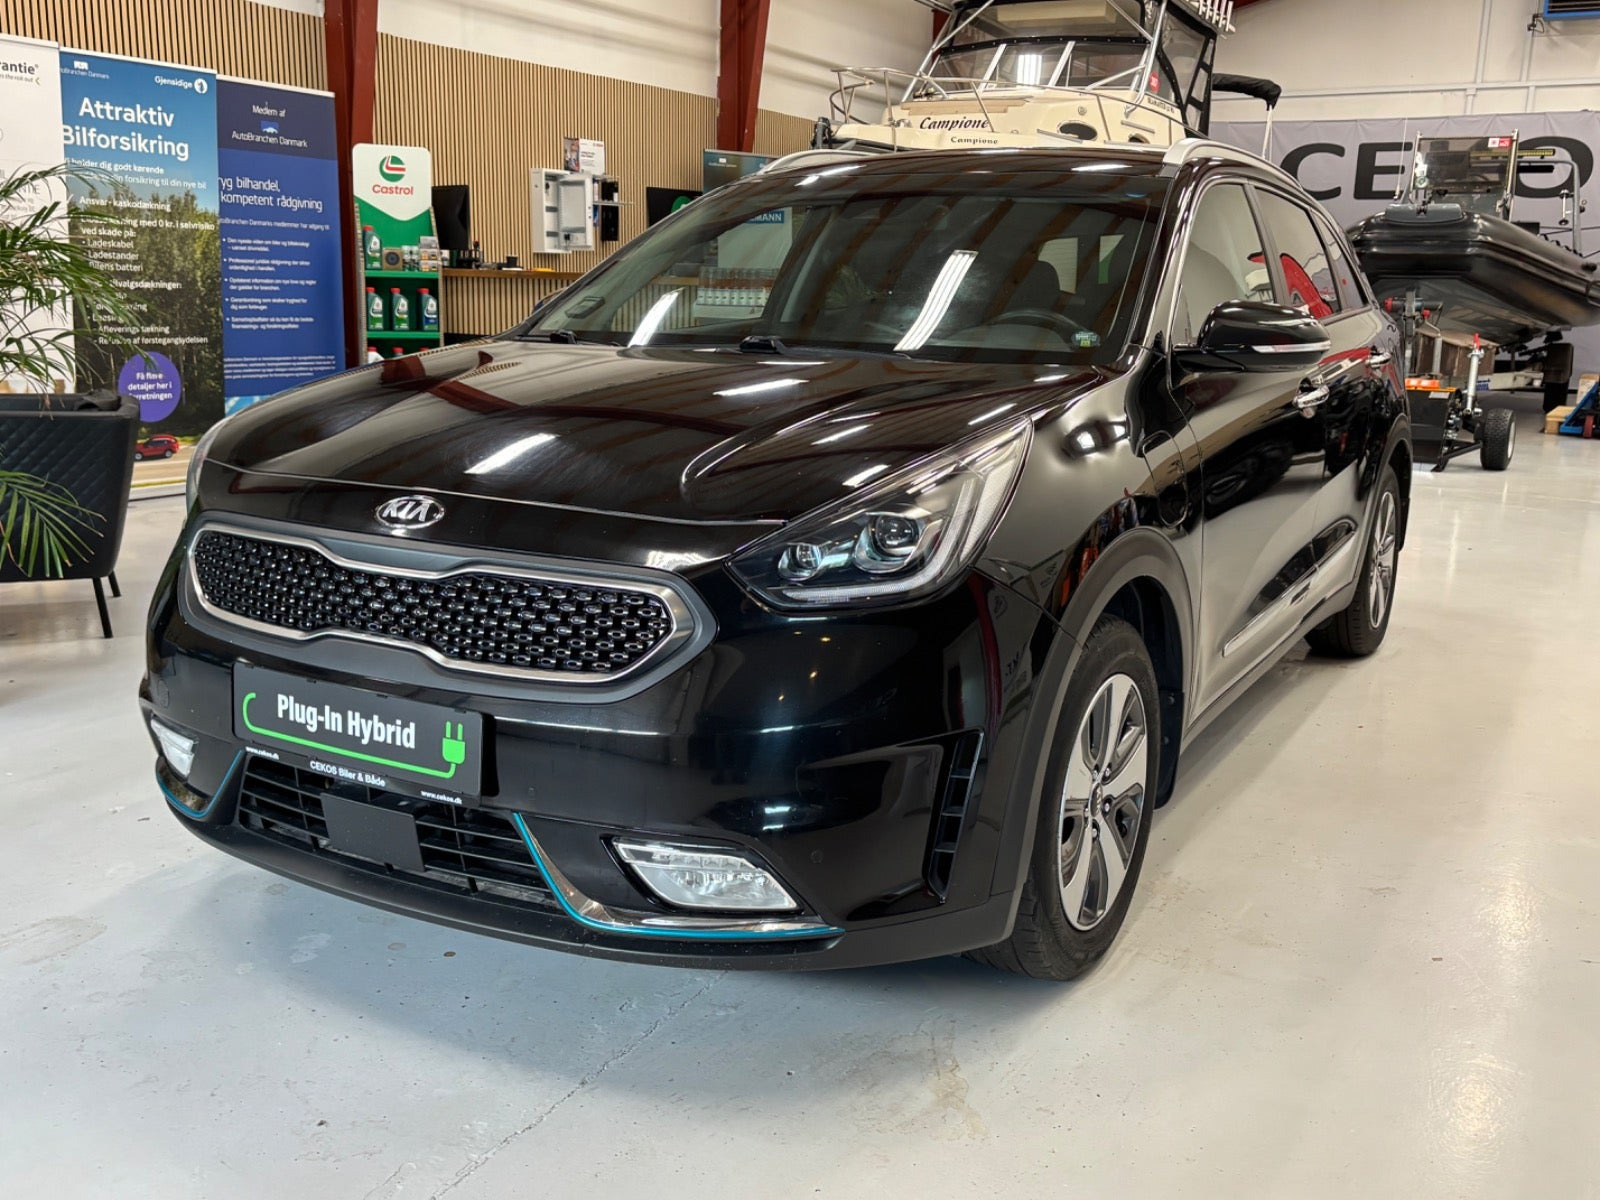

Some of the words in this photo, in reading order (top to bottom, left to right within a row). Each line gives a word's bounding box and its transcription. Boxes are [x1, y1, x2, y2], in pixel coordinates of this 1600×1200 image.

[155, 75, 192, 89] Gjensidige
[79, 97, 174, 127] Attraktiv
[279, 109, 286, 118] af
[920, 116, 989, 131] Campione
[62, 124, 189, 162] Bilforsikring
[232, 130, 278, 144] AutoBranchen
[280, 136, 308, 148] Danmark
[950, 136, 998, 145] Campione
[99, 161, 113, 171] dig
[113, 162, 132, 172] godt
[125, 174, 160, 188] forsikring
[161, 177, 169, 186] til
[170, 178, 182, 187] din
[183, 180, 196, 190] nye
[236, 176, 281, 193] bilhandel,
[372, 184, 414, 196] Castrol
[220, 190, 274, 207] kompetent
[276, 195, 323, 213] rådgivning
[140, 218, 158, 228] med
[158, 219, 165, 228] 0
[180, 220, 215, 231] selvrisiko
[82, 226, 96, 235] ved
[98, 227, 122, 237] skade
[88, 249, 139, 260] Ladestander
[115, 262, 143, 272] batteri
[133, 336, 141, 345] af
[128, 382, 156, 392] detaljer
[156, 381, 168, 390] her
[277, 693, 343, 733] Plug-In
[347, 710, 416, 749] Hybrid
[309, 760, 337, 776] CEKOS
[338, 767, 356, 780] Biler
[357, 772, 364, 782] &
[365, 773, 386, 787] Både
